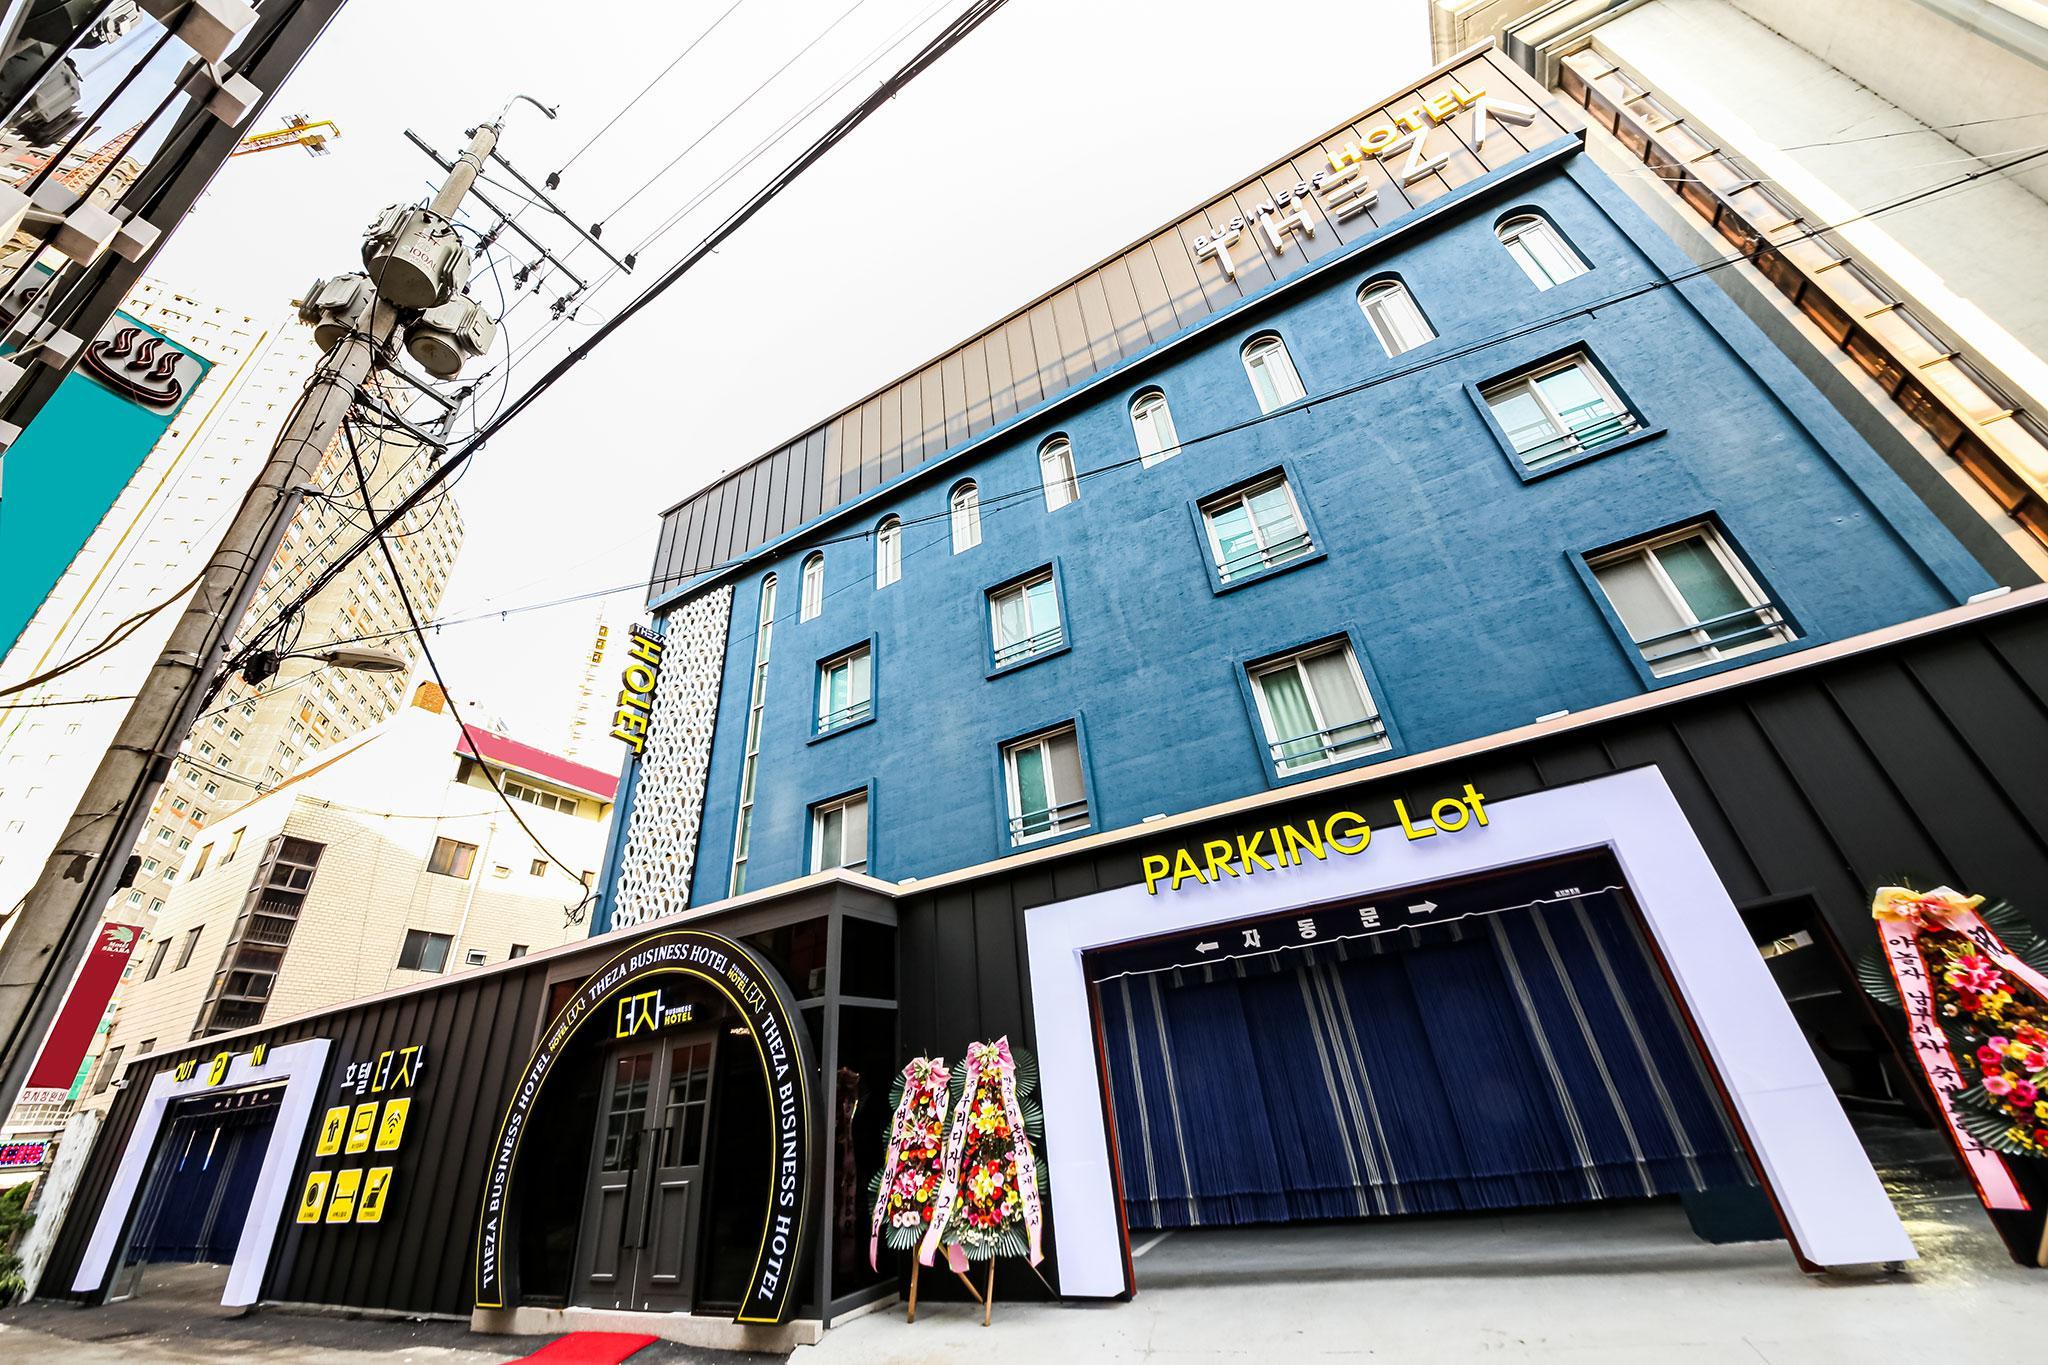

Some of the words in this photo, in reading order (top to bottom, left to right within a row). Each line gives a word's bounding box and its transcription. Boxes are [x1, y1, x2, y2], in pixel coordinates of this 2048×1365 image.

[1193, 170, 1326, 249] BUSINESS
[1327, 82, 1487, 171] HOTEL
[610, 636, 662, 755] HOTEL
[1141, 810, 1373, 895] PARKING
[1393, 783, 1490, 842] Lot
[589, 964, 628, 1001] THEZA
[630, 943, 689, 972] BUSINESS
[689, 945, 728, 974] HOTEL
[727, 969, 748, 993] HOTEL
[1889, 935, 1925, 980] 야놀자
[549, 1024, 569, 1052] HOTEL
[664, 1011, 693, 1026] HOTEL
[665, 1004, 692, 1015] BUSINESS
[1906, 990, 1945, 1054] 남부지사
[173, 1058, 197, 1082] OUT
[250, 1043, 267, 1066] IN
[760, 1012, 789, 1081] THEZA
[340, 1061, 373, 1095] 호텔
[518, 1053, 551, 1112] HOTEL
[489, 1114, 522, 1211] BUSINESS
[778, 1081, 799, 1207] BUSINESS
[483, 1218, 500, 1289] THEZA
[757, 1216, 792, 1302] HOTEL
